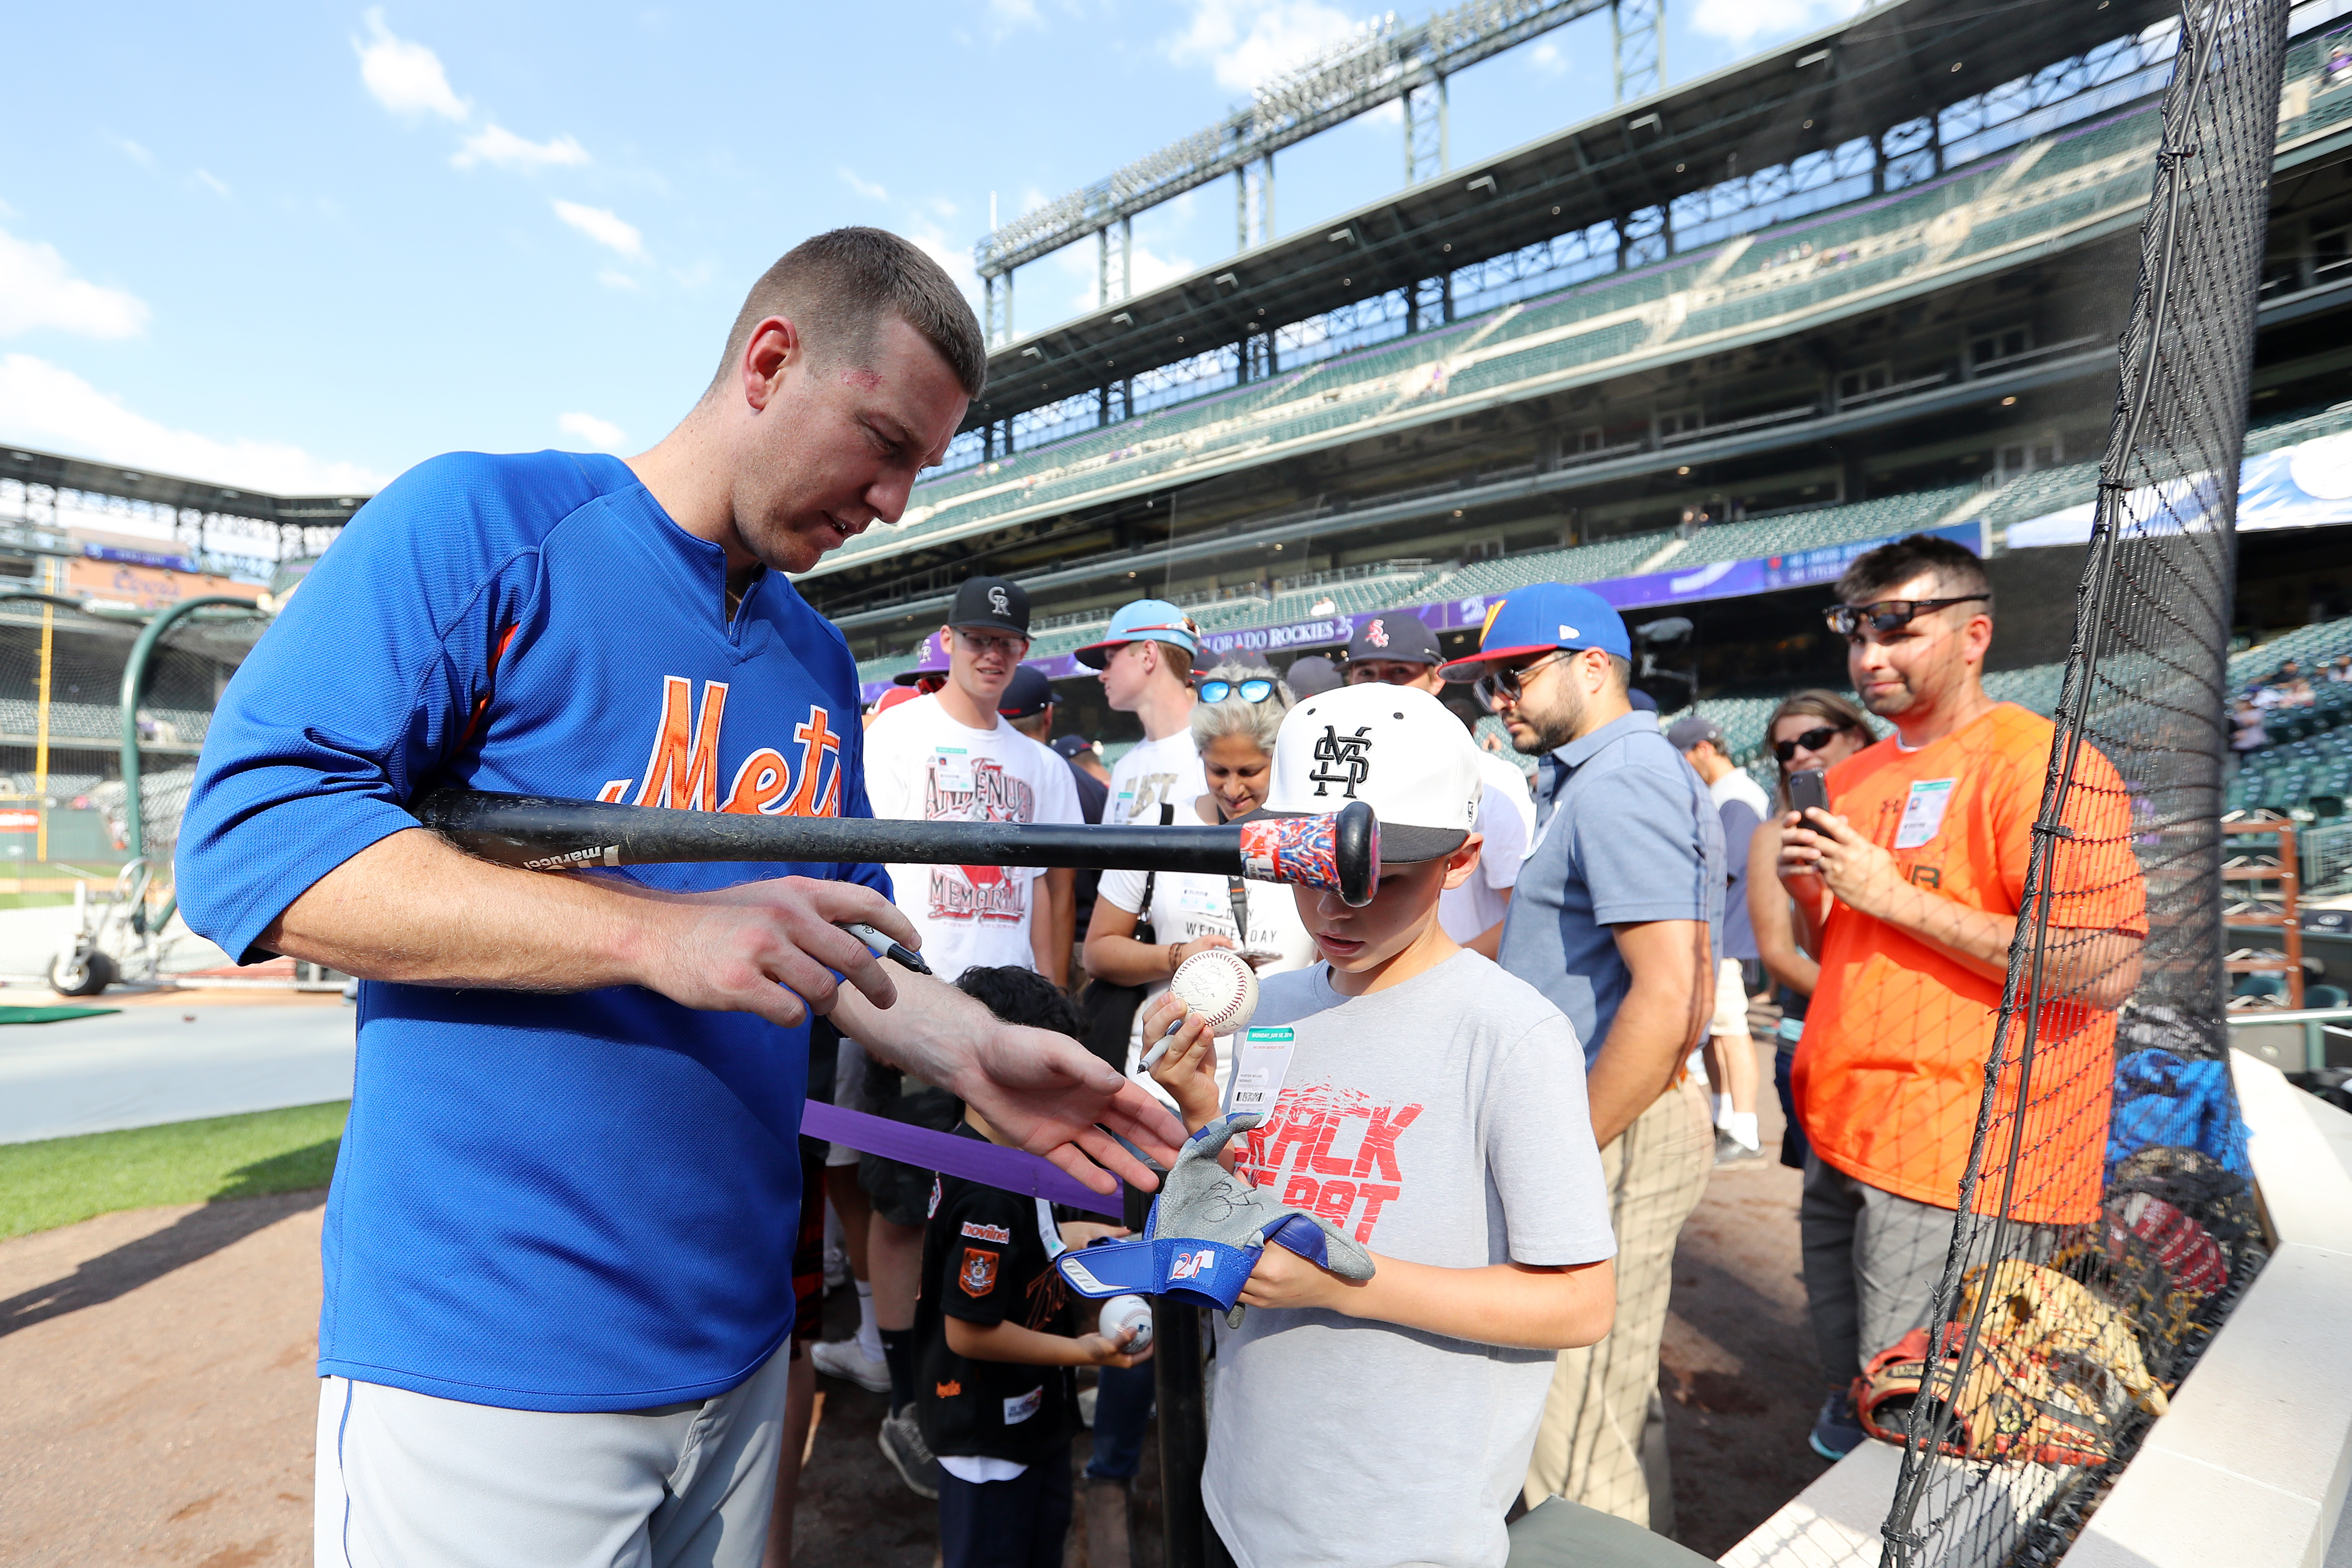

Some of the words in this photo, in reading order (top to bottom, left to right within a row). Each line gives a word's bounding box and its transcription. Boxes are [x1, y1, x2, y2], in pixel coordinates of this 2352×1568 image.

[1267, 620, 1335, 649] ROCKIES
[523, 846, 602, 870] marucci
[1186, 922, 1277, 943] WEDNEDAY
[1235, 1089, 1425, 1182] RACK
[1173, 1253, 1203, 1278] 21
